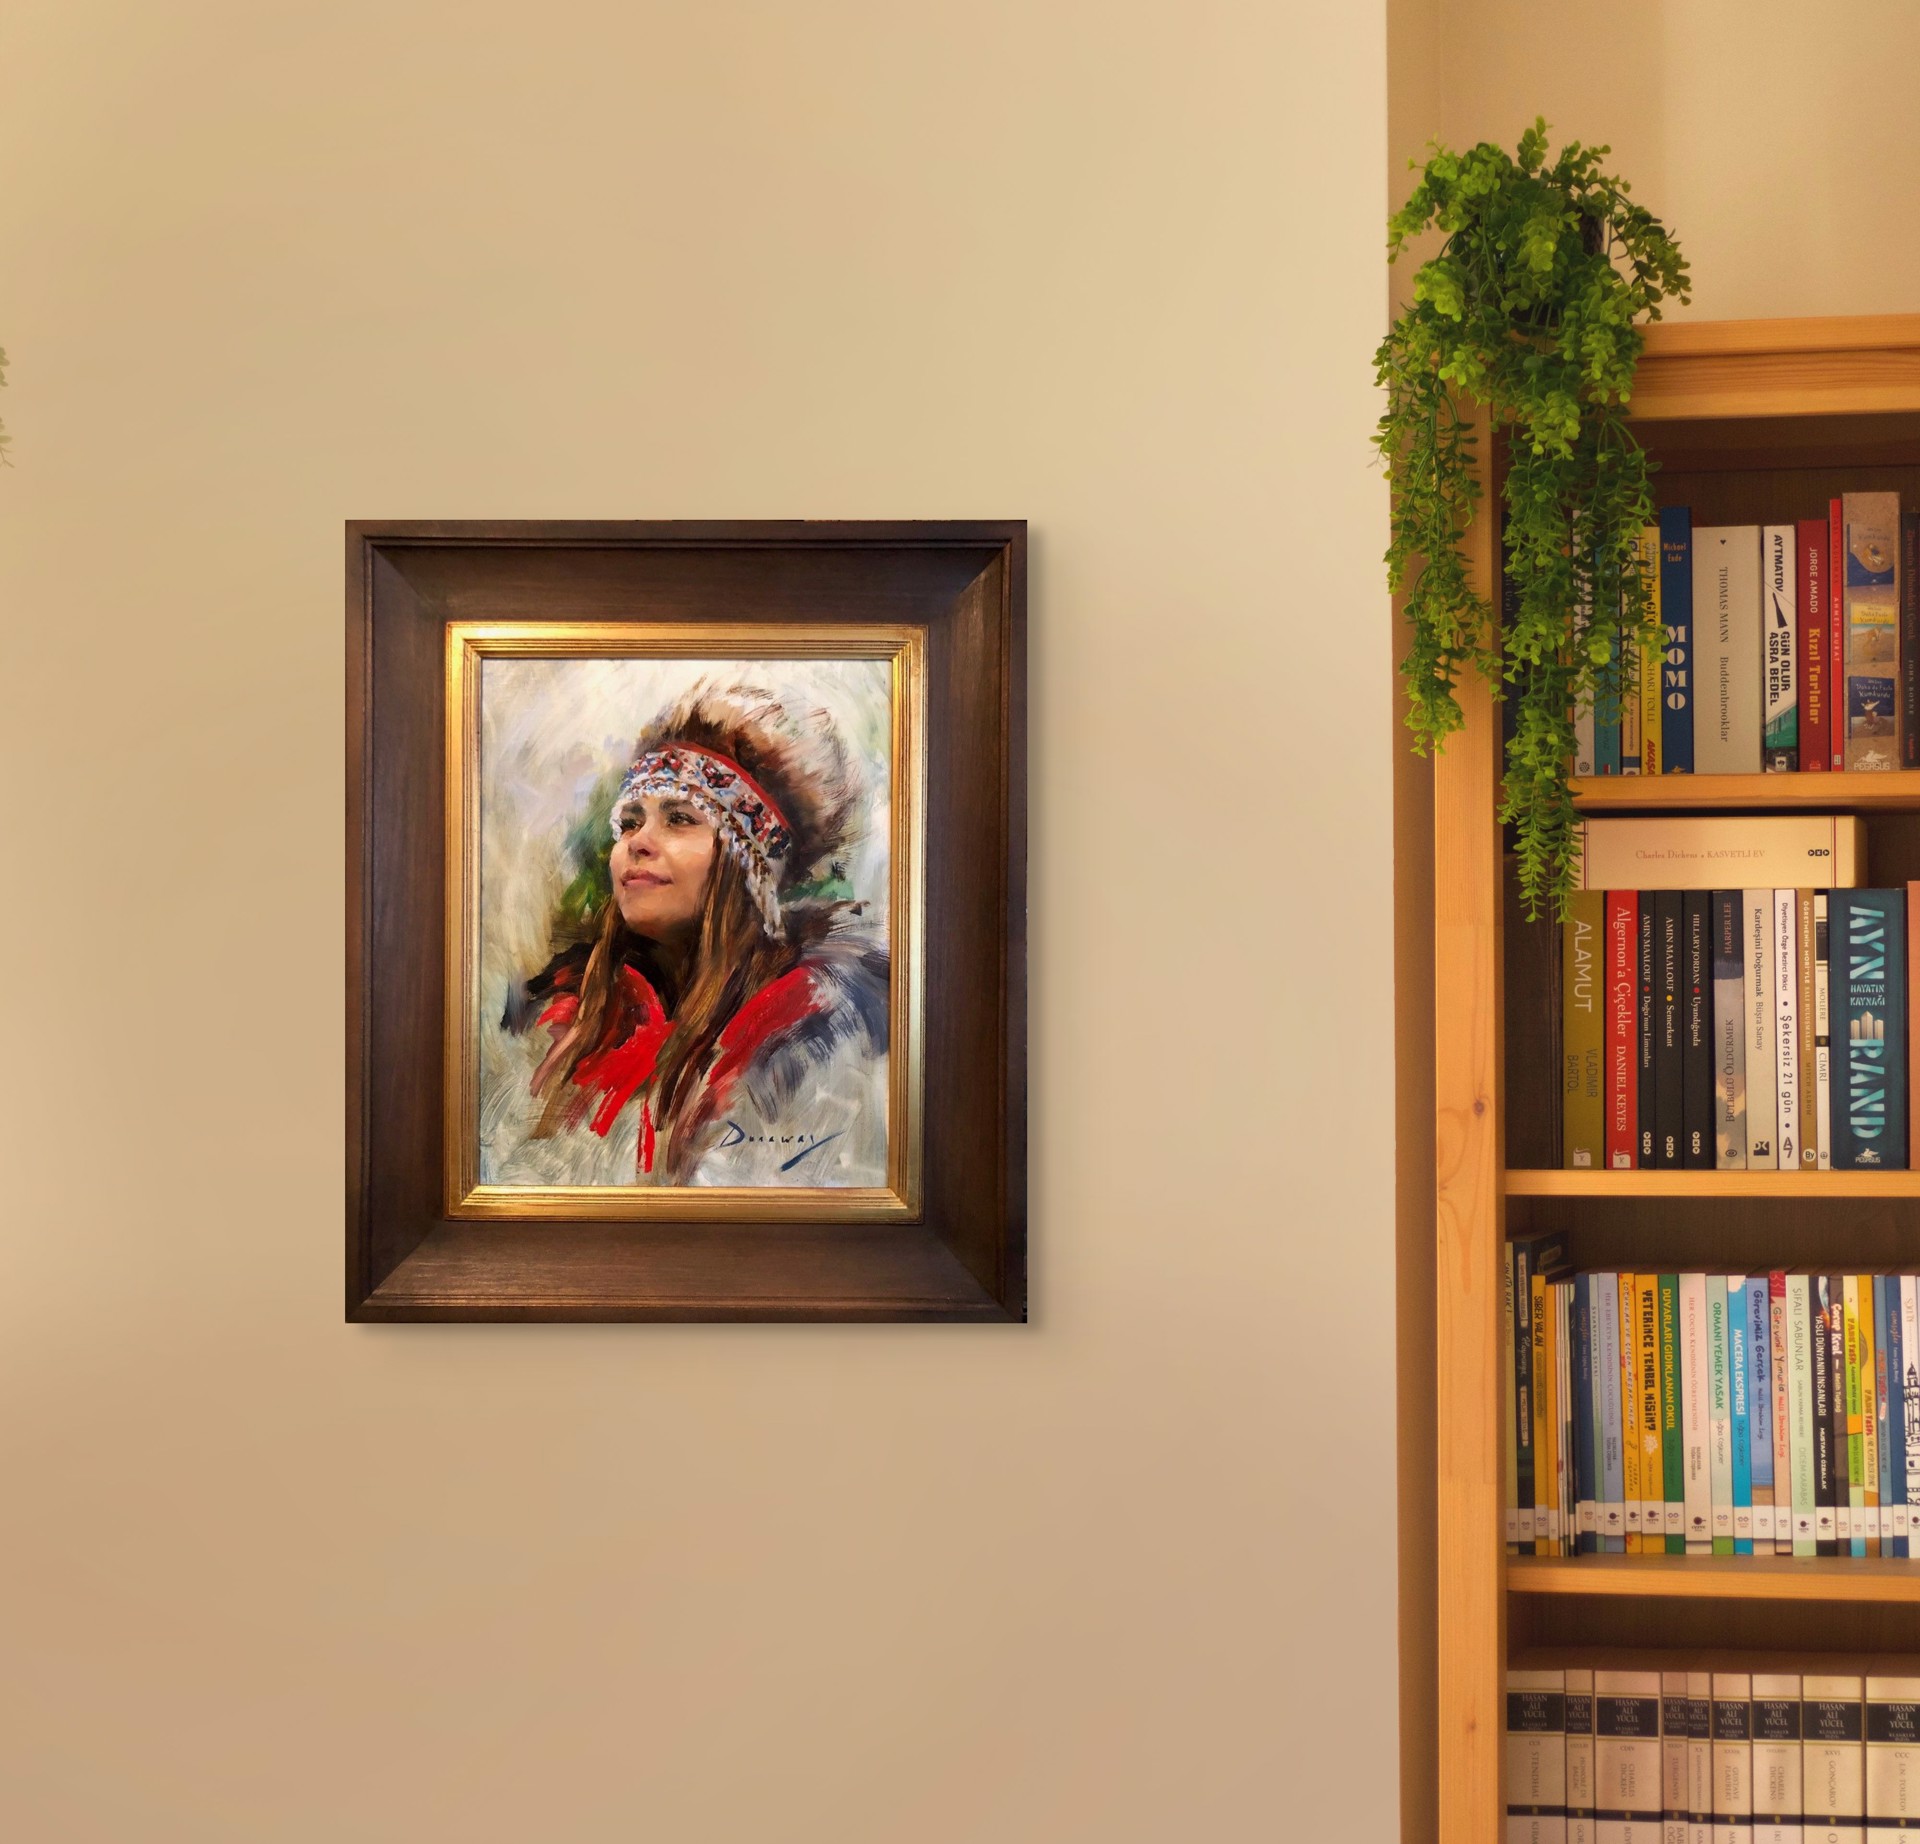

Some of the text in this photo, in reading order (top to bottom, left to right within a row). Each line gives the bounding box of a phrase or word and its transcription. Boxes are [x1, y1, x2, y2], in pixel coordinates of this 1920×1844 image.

[1773, 534, 1784, 593] AYTMATOV
[1809, 547, 1821, 725] JORGE AMADO Kızıl Tarlalar
[1833, 597, 1841, 664] AHMET MURAT
[1664, 625, 1688, 711] MOMO
[1719, 566, 1730, 743] THOMAS MANN Buddenbrooklar
[1769, 632, 1781, 707] ASRA BEDEL
[1780, 631, 1792, 692] GÜN OLUR
[1647, 697, 1656, 724] TOLLE
[1854, 762, 1890, 771] PEGASUS
[1635, 848, 1766, 860] Charles Dickens KASVETLİ EV
[1724, 902, 1733, 955] HARPER LEE
[1574, 920, 1592, 1013] ALAMUT
[1665, 916, 1676, 1048] AMIN MAALOUF Semerkant
[1690, 913, 1702, 1047] HILLARY JORDAN Uyandığında
[1753, 908, 1766, 1052] Kardeşini Doğurmak Büşra Sanay
[1641, 913, 1652, 1069] AMIN MAALOUF Doğu'nun Limanları
[1780, 902, 1793, 1115] Diyetisyen Özge Bezirci Dikici Şekersiz 21 gün
[1850, 984, 1885, 994] HAYATIN
[1850, 994, 1886, 1006] KAYNAĞI
[1612, 907, 1633, 1132] Algernon'a Çiçekler DANIEL KEYES
[1849, 906, 1885, 1138] AYN RAND
[1567, 1054, 1580, 1094] BARTOL
[1818, 1052, 1828, 1082] CİMRİ
[1805, 1151, 1815, 1160] By
[1662, 1288, 1673, 1343] DUVARLARI
[1688, 1296, 1696, 1311] HER
[1792, 1287, 1804, 1316] ŞİFALI
[1830, 1303, 1843, 1331] Çorap
[1712, 1301, 1725, 1410] ORMANI YEMEK YASAK
[1755, 1344, 1767, 1383] Gerçek
[1793, 1319, 1805, 1372] SABUNLAR
[1831, 1333, 1843, 1356] Kral
[1643, 1351, 1656, 1391] TEMBEL
[1664, 1345, 1675, 1403] GIDIKLANAN
[1733, 1328, 1747, 1416] MACERA EKSPRESİ
[1666, 1404, 1676, 1431] OKUL
[1814, 1314, 1829, 1491] YAŞLI DÜNYANIN İNSANLARI MUSTAFA ÖZBALAK
[1719, 1702, 1744, 1710] HASAN
[1764, 1702, 1790, 1710] HASAN
[1819, 1703, 1846, 1711] HASAN
[1820, 1718, 1845, 1728] YÜCEL
[1889, 1704, 1916, 1713] HASAN
[1890, 1719, 1915, 1729] YÜCEL
[1530, 1751, 1540, 1799] STENDHAL
[1620, 1763, 1628, 1799] DICKENS
[1628, 1763, 1636, 1799] CHARLES
[1769, 1766, 1778, 1801] DICKENS
[1777, 1766, 1786, 1801] CHARLES
[1898, 1778, 1908, 1813] TOLSTOY
